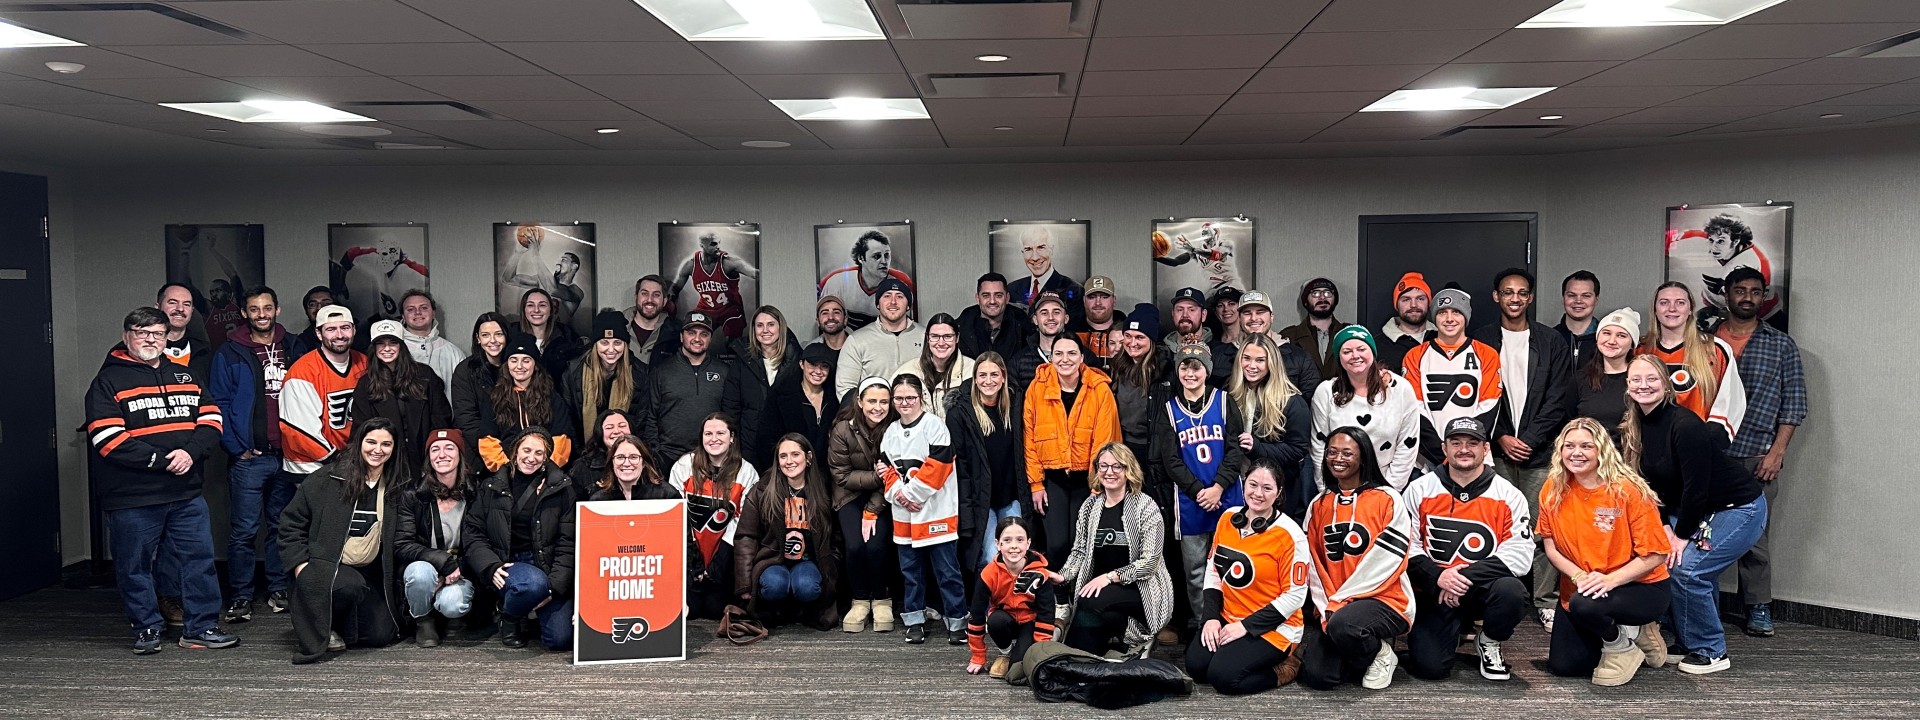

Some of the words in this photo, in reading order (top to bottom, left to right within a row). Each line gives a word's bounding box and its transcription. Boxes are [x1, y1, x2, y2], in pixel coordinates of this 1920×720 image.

[696, 280, 729, 293] SIXERS
[701, 292, 728, 308] 34
[213, 310, 241, 325] SIXERS
[1464, 352, 1478, 370] A
[128, 397, 166, 413] BROAD
[167, 394, 201, 407] STREET
[148, 406, 191, 420] BULLIES
[1178, 424, 1224, 448] PHILA
[1196, 443, 1212, 464] 0
[1520, 516, 1533, 540] 3
[617, 544, 646, 554] WELCOME
[599, 554, 664, 578] PROJECT
[1292, 561, 1309, 586] 0
[608, 578, 655, 601] HOME
